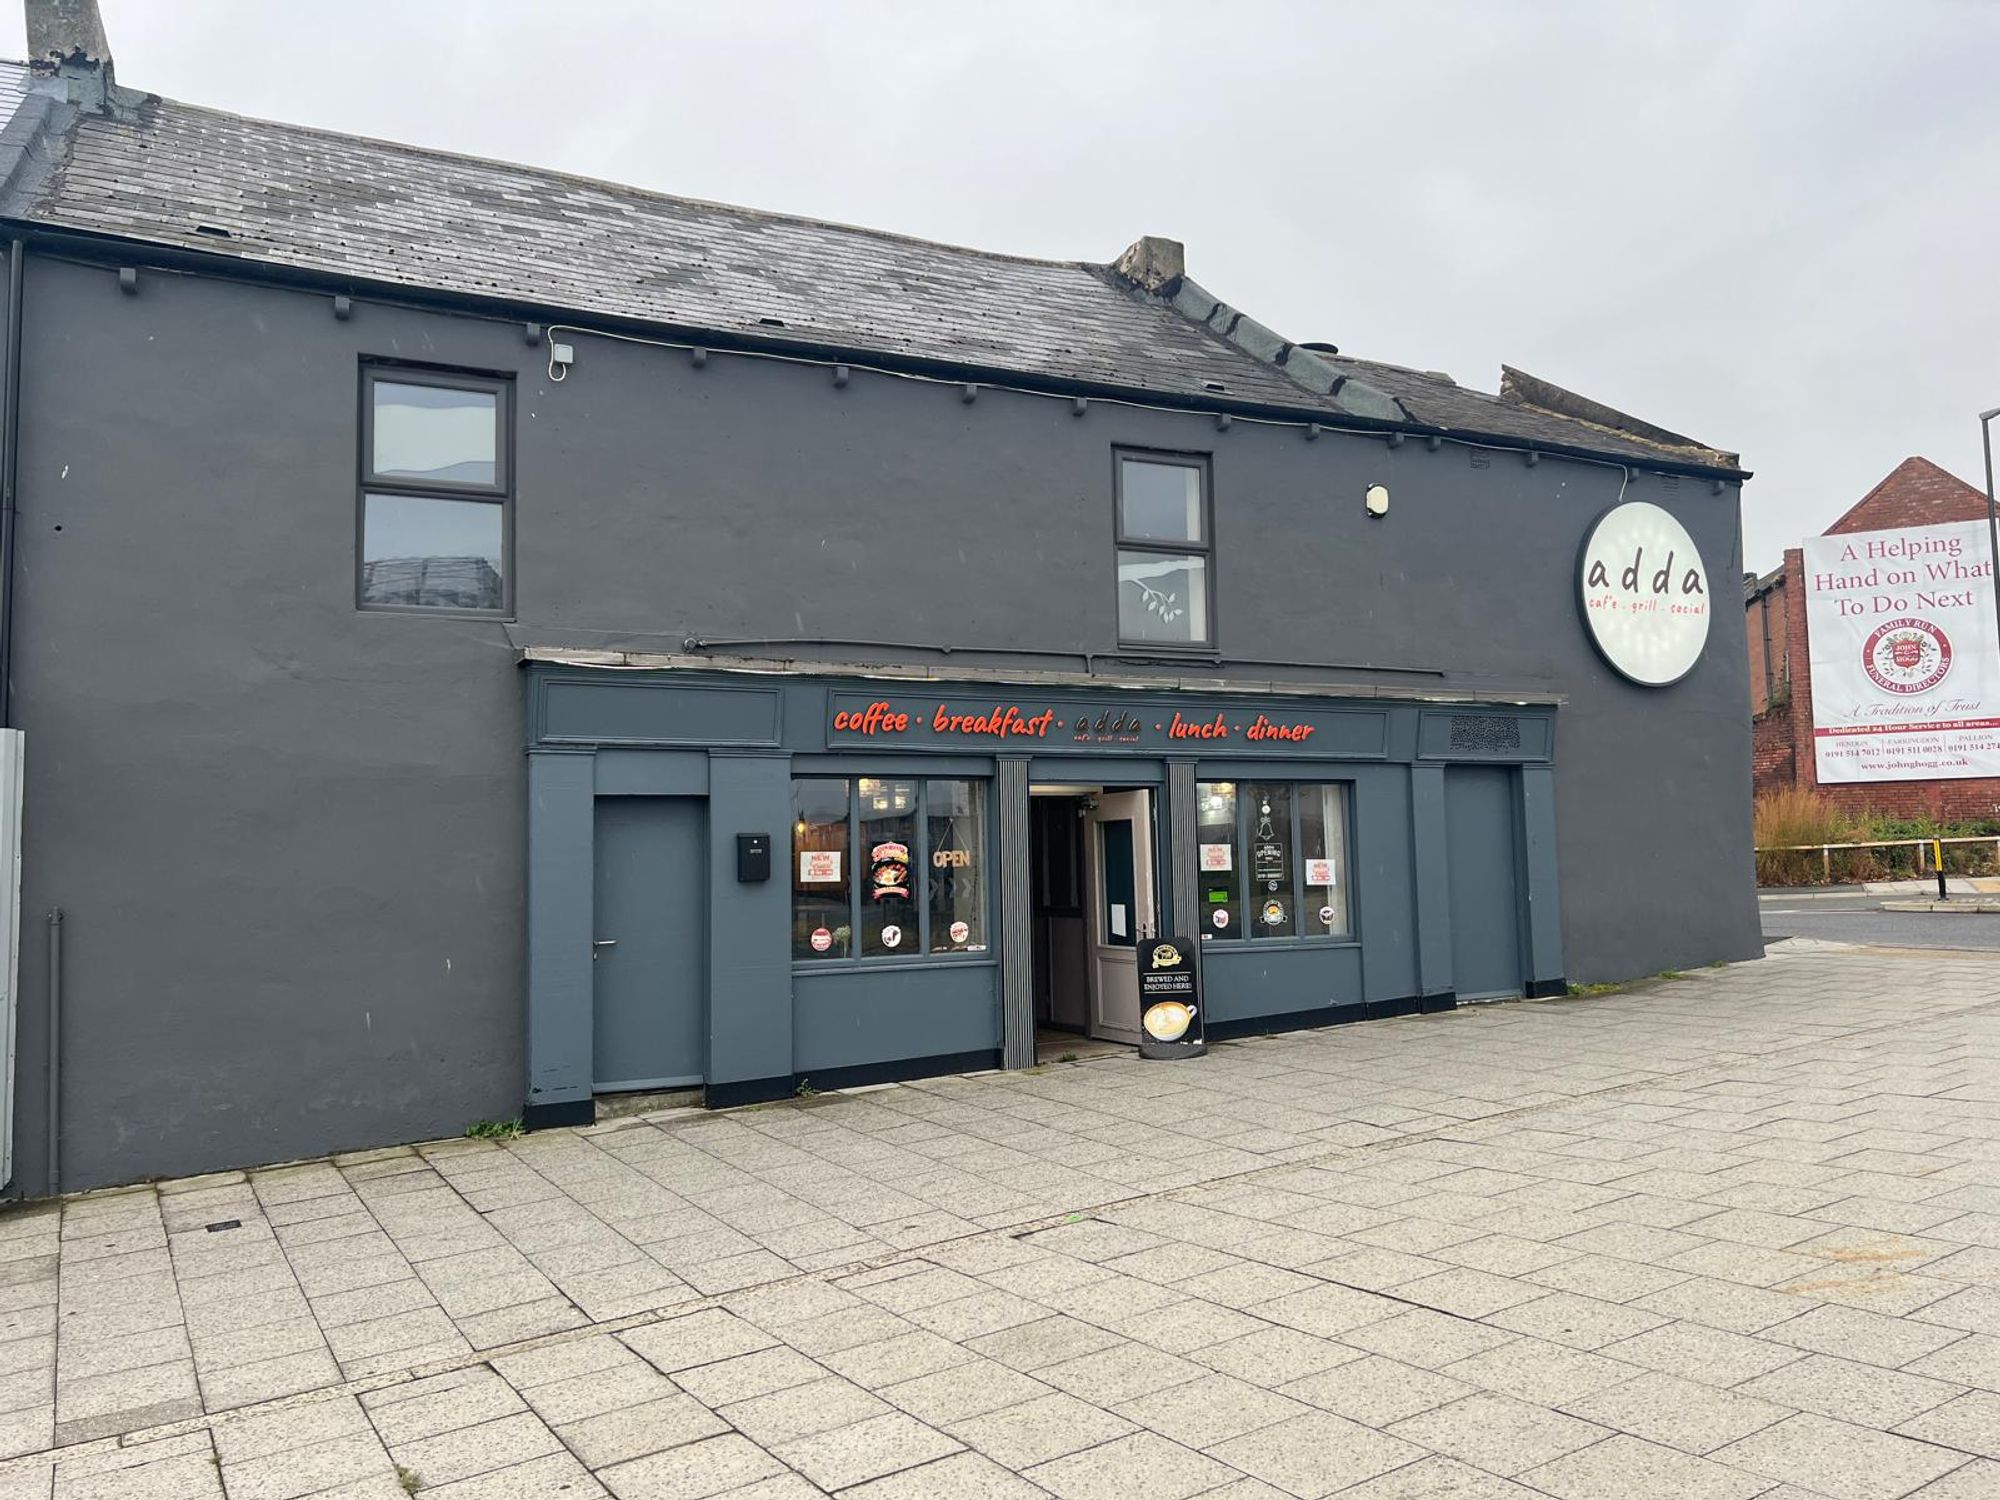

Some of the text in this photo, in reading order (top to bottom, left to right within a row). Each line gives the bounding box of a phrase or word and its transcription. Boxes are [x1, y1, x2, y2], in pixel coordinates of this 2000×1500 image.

[1840, 536, 1962, 562] A Helping
[1587, 546, 1704, 595] adda
[1815, 560, 1993, 591] Hand on What
[1631, 600, 1657, 613] grill
[1834, 590, 1974, 616] To Do Next
[1874, 619, 1938, 638] FAMILY RUN
[1866, 657, 1950, 692] FUNERAL DIRECTORS
[1864, 703, 1923, 716] Tradition
[1925, 700, 1945, 716] of
[1945, 698, 1981, 711] Trust
[834, 701, 1316, 742] coffee breakfast adda lunch dinner
[1829, 726, 1871, 734] Dedicated
[1860, 757, 1969, 770] www.johnghogg.co.uk
[933, 850, 970, 869] OPEN
